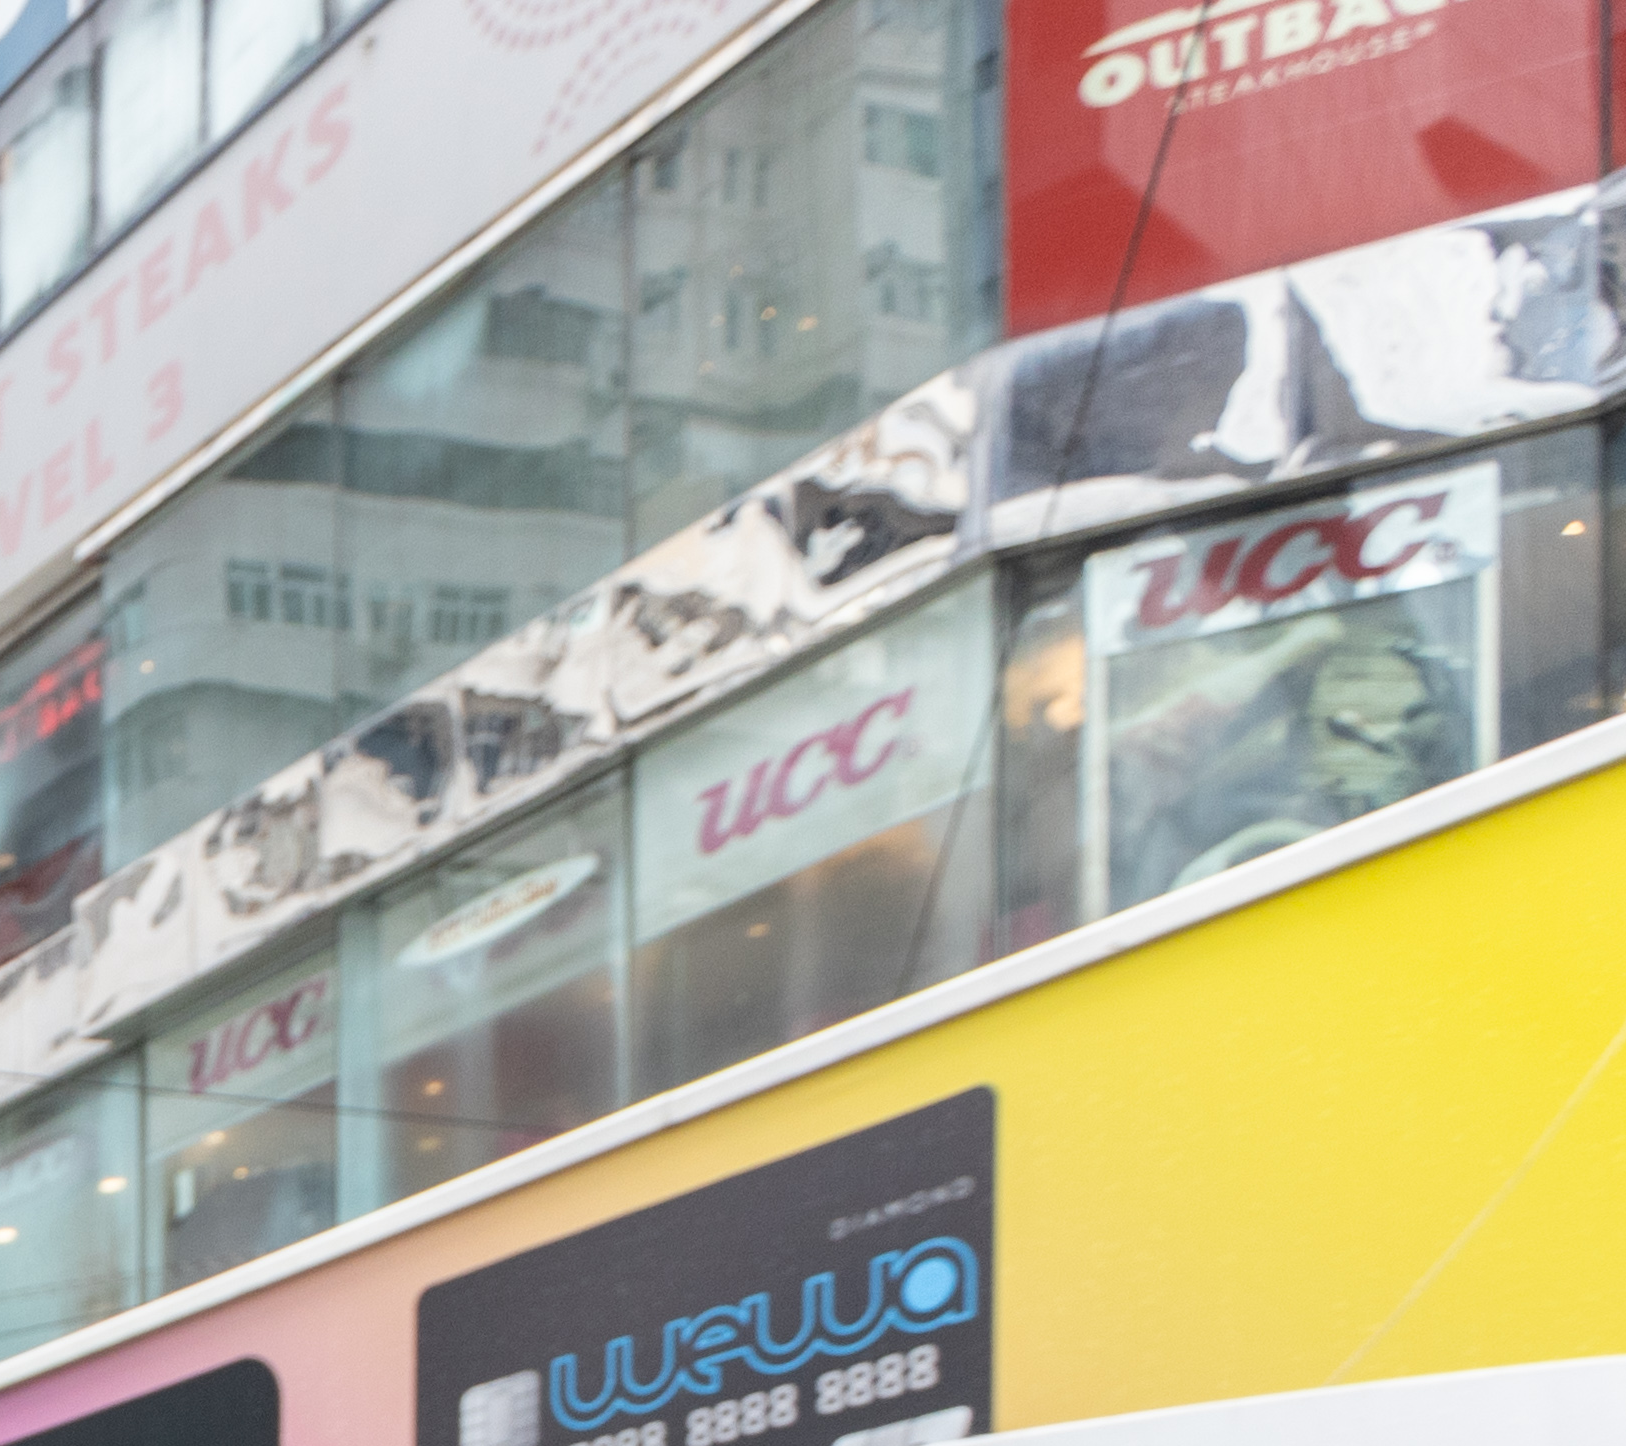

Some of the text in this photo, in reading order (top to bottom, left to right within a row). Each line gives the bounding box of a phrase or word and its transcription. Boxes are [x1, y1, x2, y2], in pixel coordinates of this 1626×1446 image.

[44, 83, 354, 408] STEAKS
[145, 356, 187, 445] 3
[1126, 490, 1451, 630] UCC
[695, 686, 916, 856] UCC
[187, 976, 332, 1096] UCC
[815, 1342, 941, 1417] 8888
